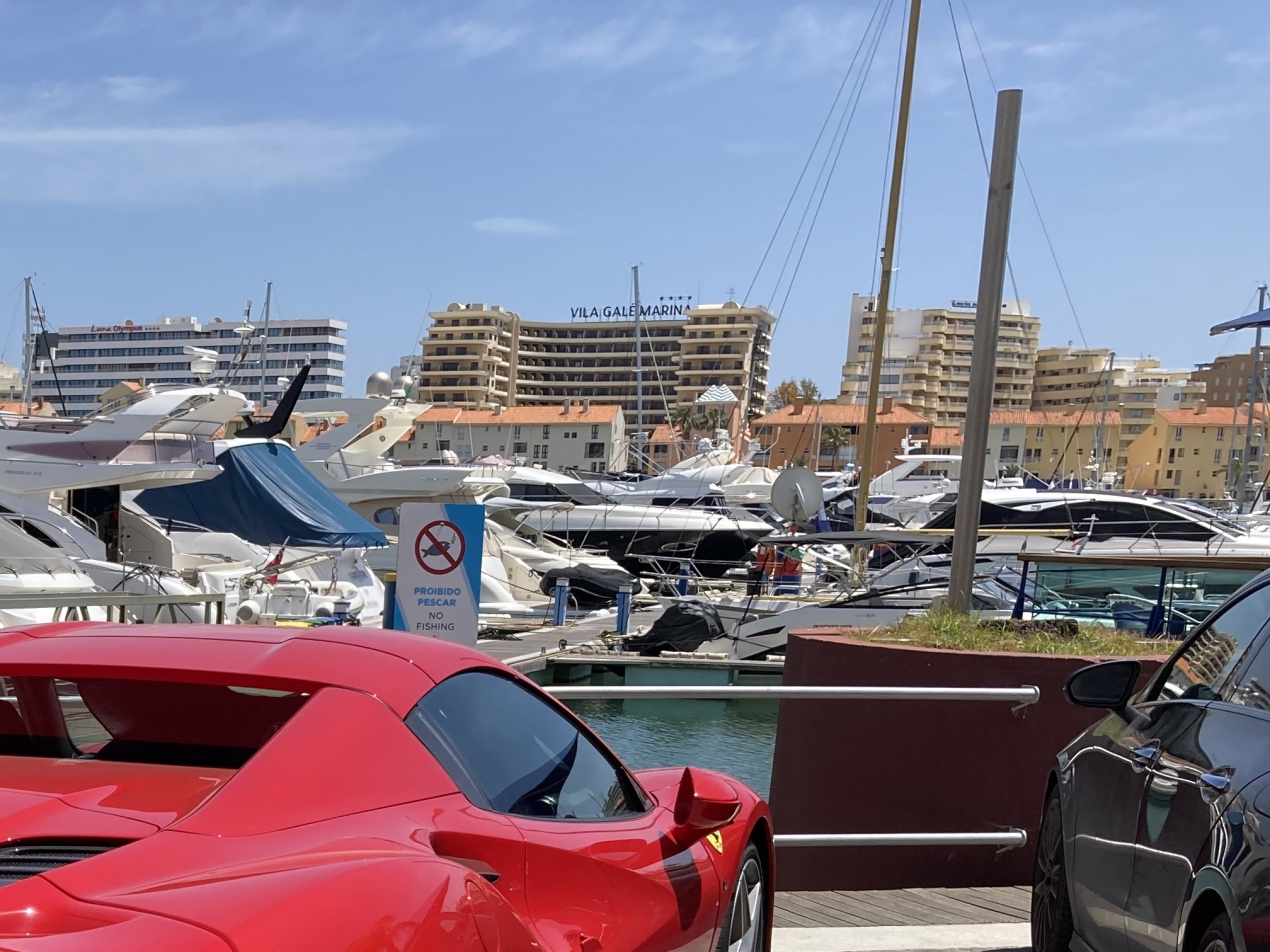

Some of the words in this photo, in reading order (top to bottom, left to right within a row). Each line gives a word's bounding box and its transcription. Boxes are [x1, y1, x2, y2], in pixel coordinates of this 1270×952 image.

[570, 307, 599, 318] VILA
[603, 303, 636, 317] GALÉ
[113, 325, 143, 333] Olympus
[414, 587, 461, 596] PROIBIDO
[417, 598, 457, 607] PESCAR
[428, 611, 444, 620] NO
[416, 622, 455, 631] FISHING
